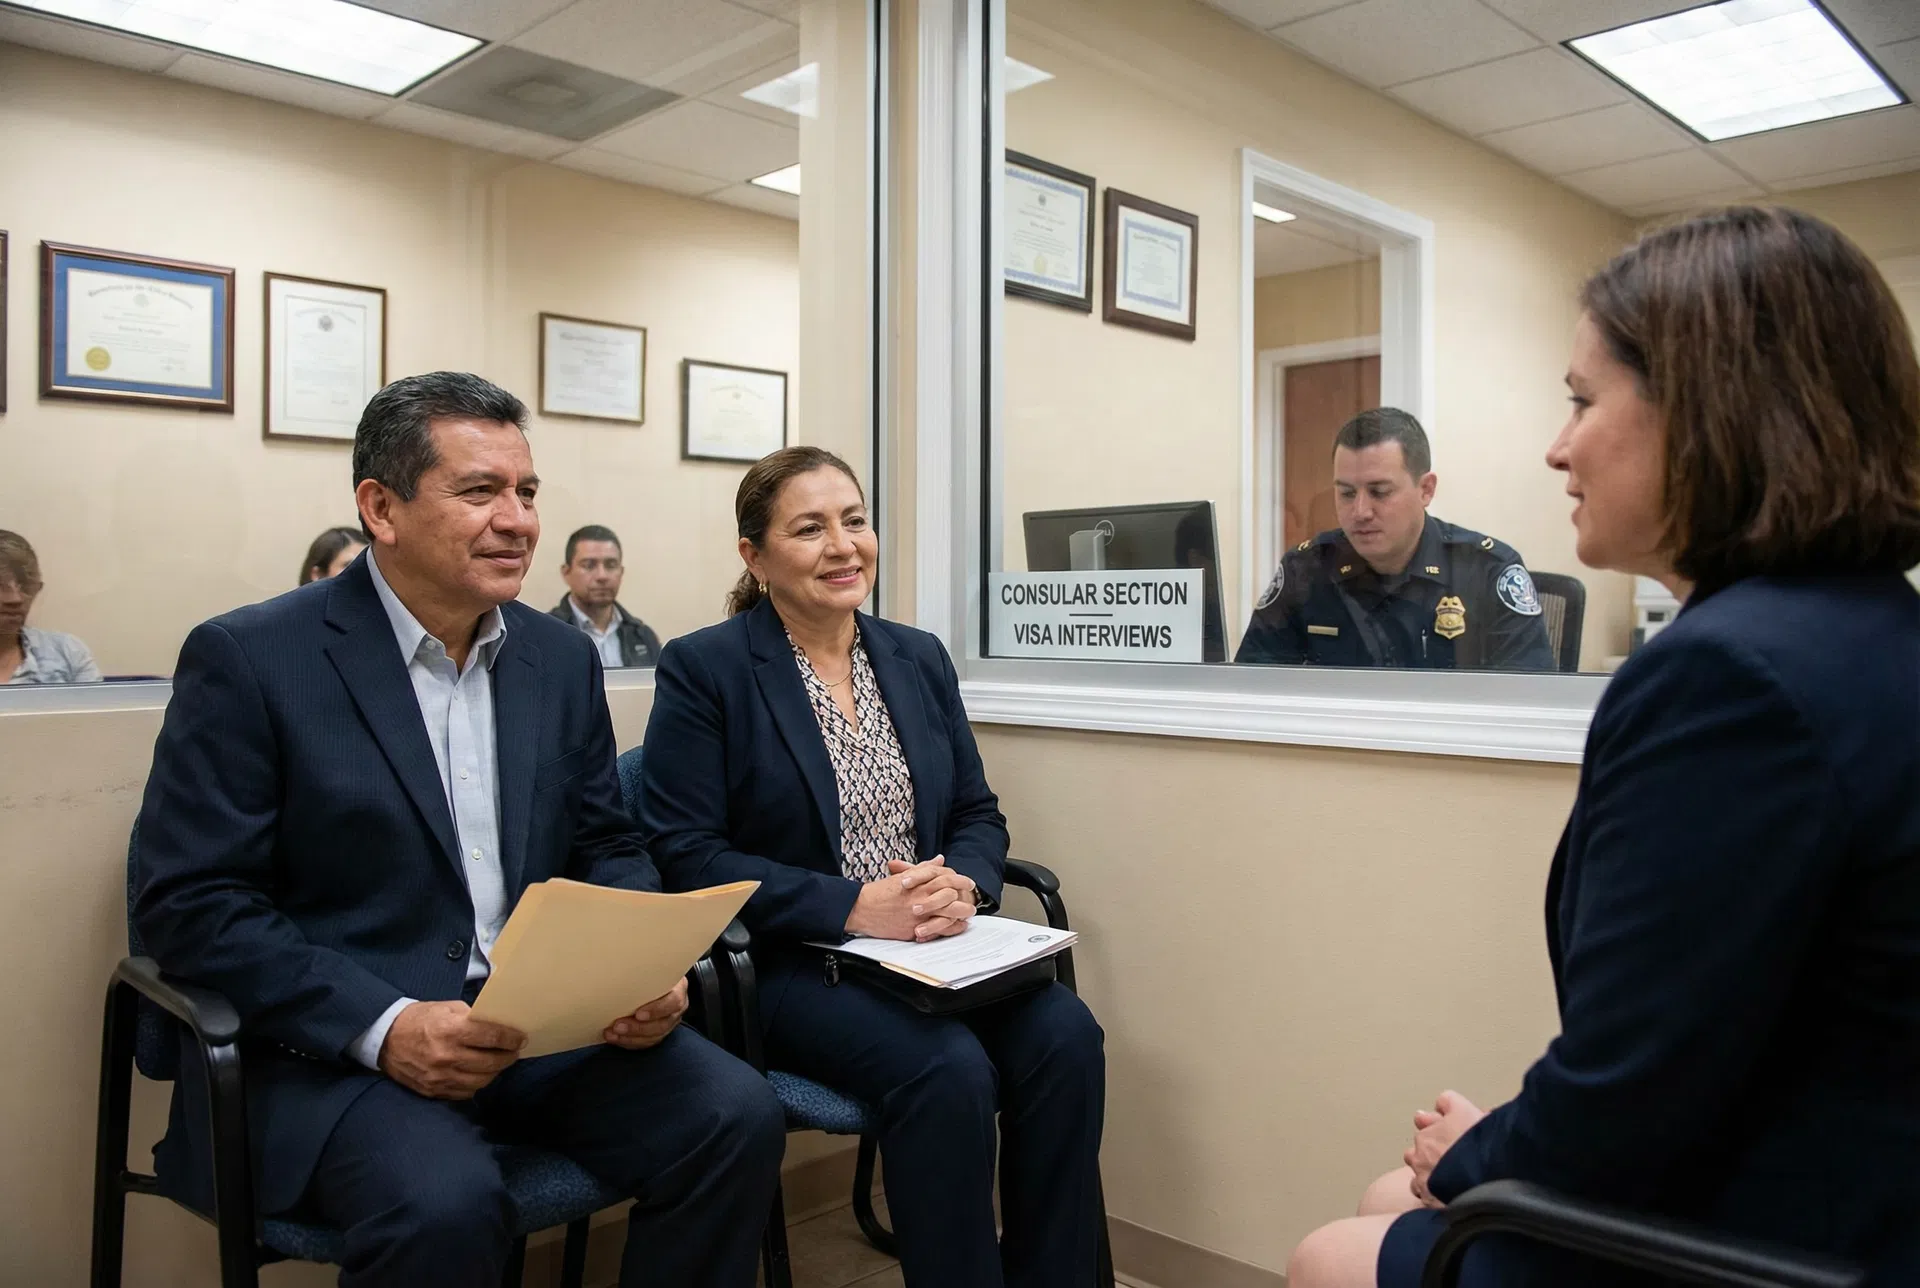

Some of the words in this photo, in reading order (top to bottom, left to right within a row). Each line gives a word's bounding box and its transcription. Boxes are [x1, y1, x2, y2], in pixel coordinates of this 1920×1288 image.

[1001, 583, 1098, 606] CONSULAR
[1103, 581, 1188, 606] SECTION
[1013, 623, 1054, 646] VISA
[1058, 624, 1172, 649] INTERVIEWS
